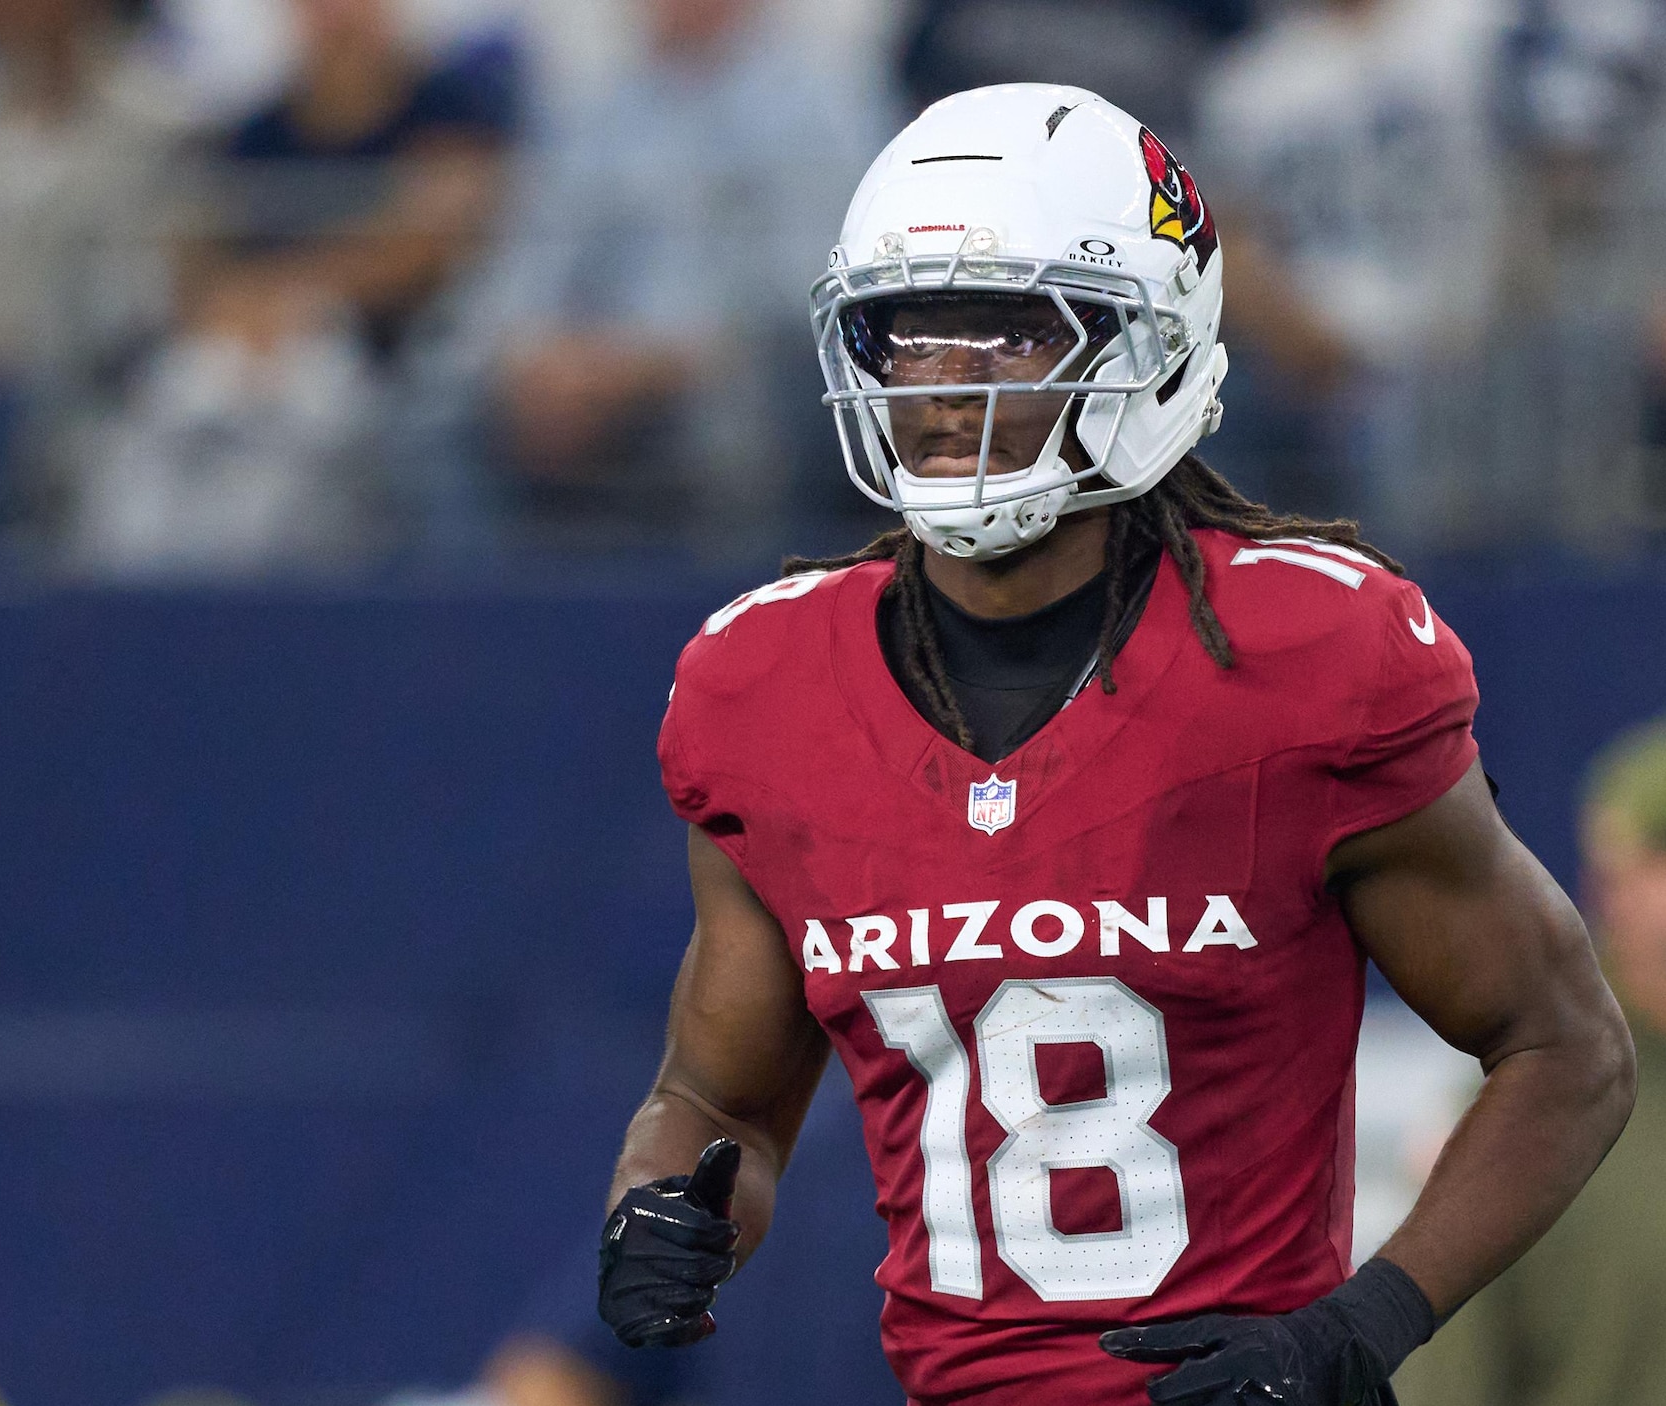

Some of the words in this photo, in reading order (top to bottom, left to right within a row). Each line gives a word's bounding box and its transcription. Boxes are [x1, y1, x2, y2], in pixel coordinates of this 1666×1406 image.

[908, 224, 966, 234] CARDINALS
[1069, 253, 1123, 268] OAKLEY
[976, 801, 1007, 824] NFL
[802, 895, 1258, 975] ARIZONA
[859, 976, 1190, 1302] 18
